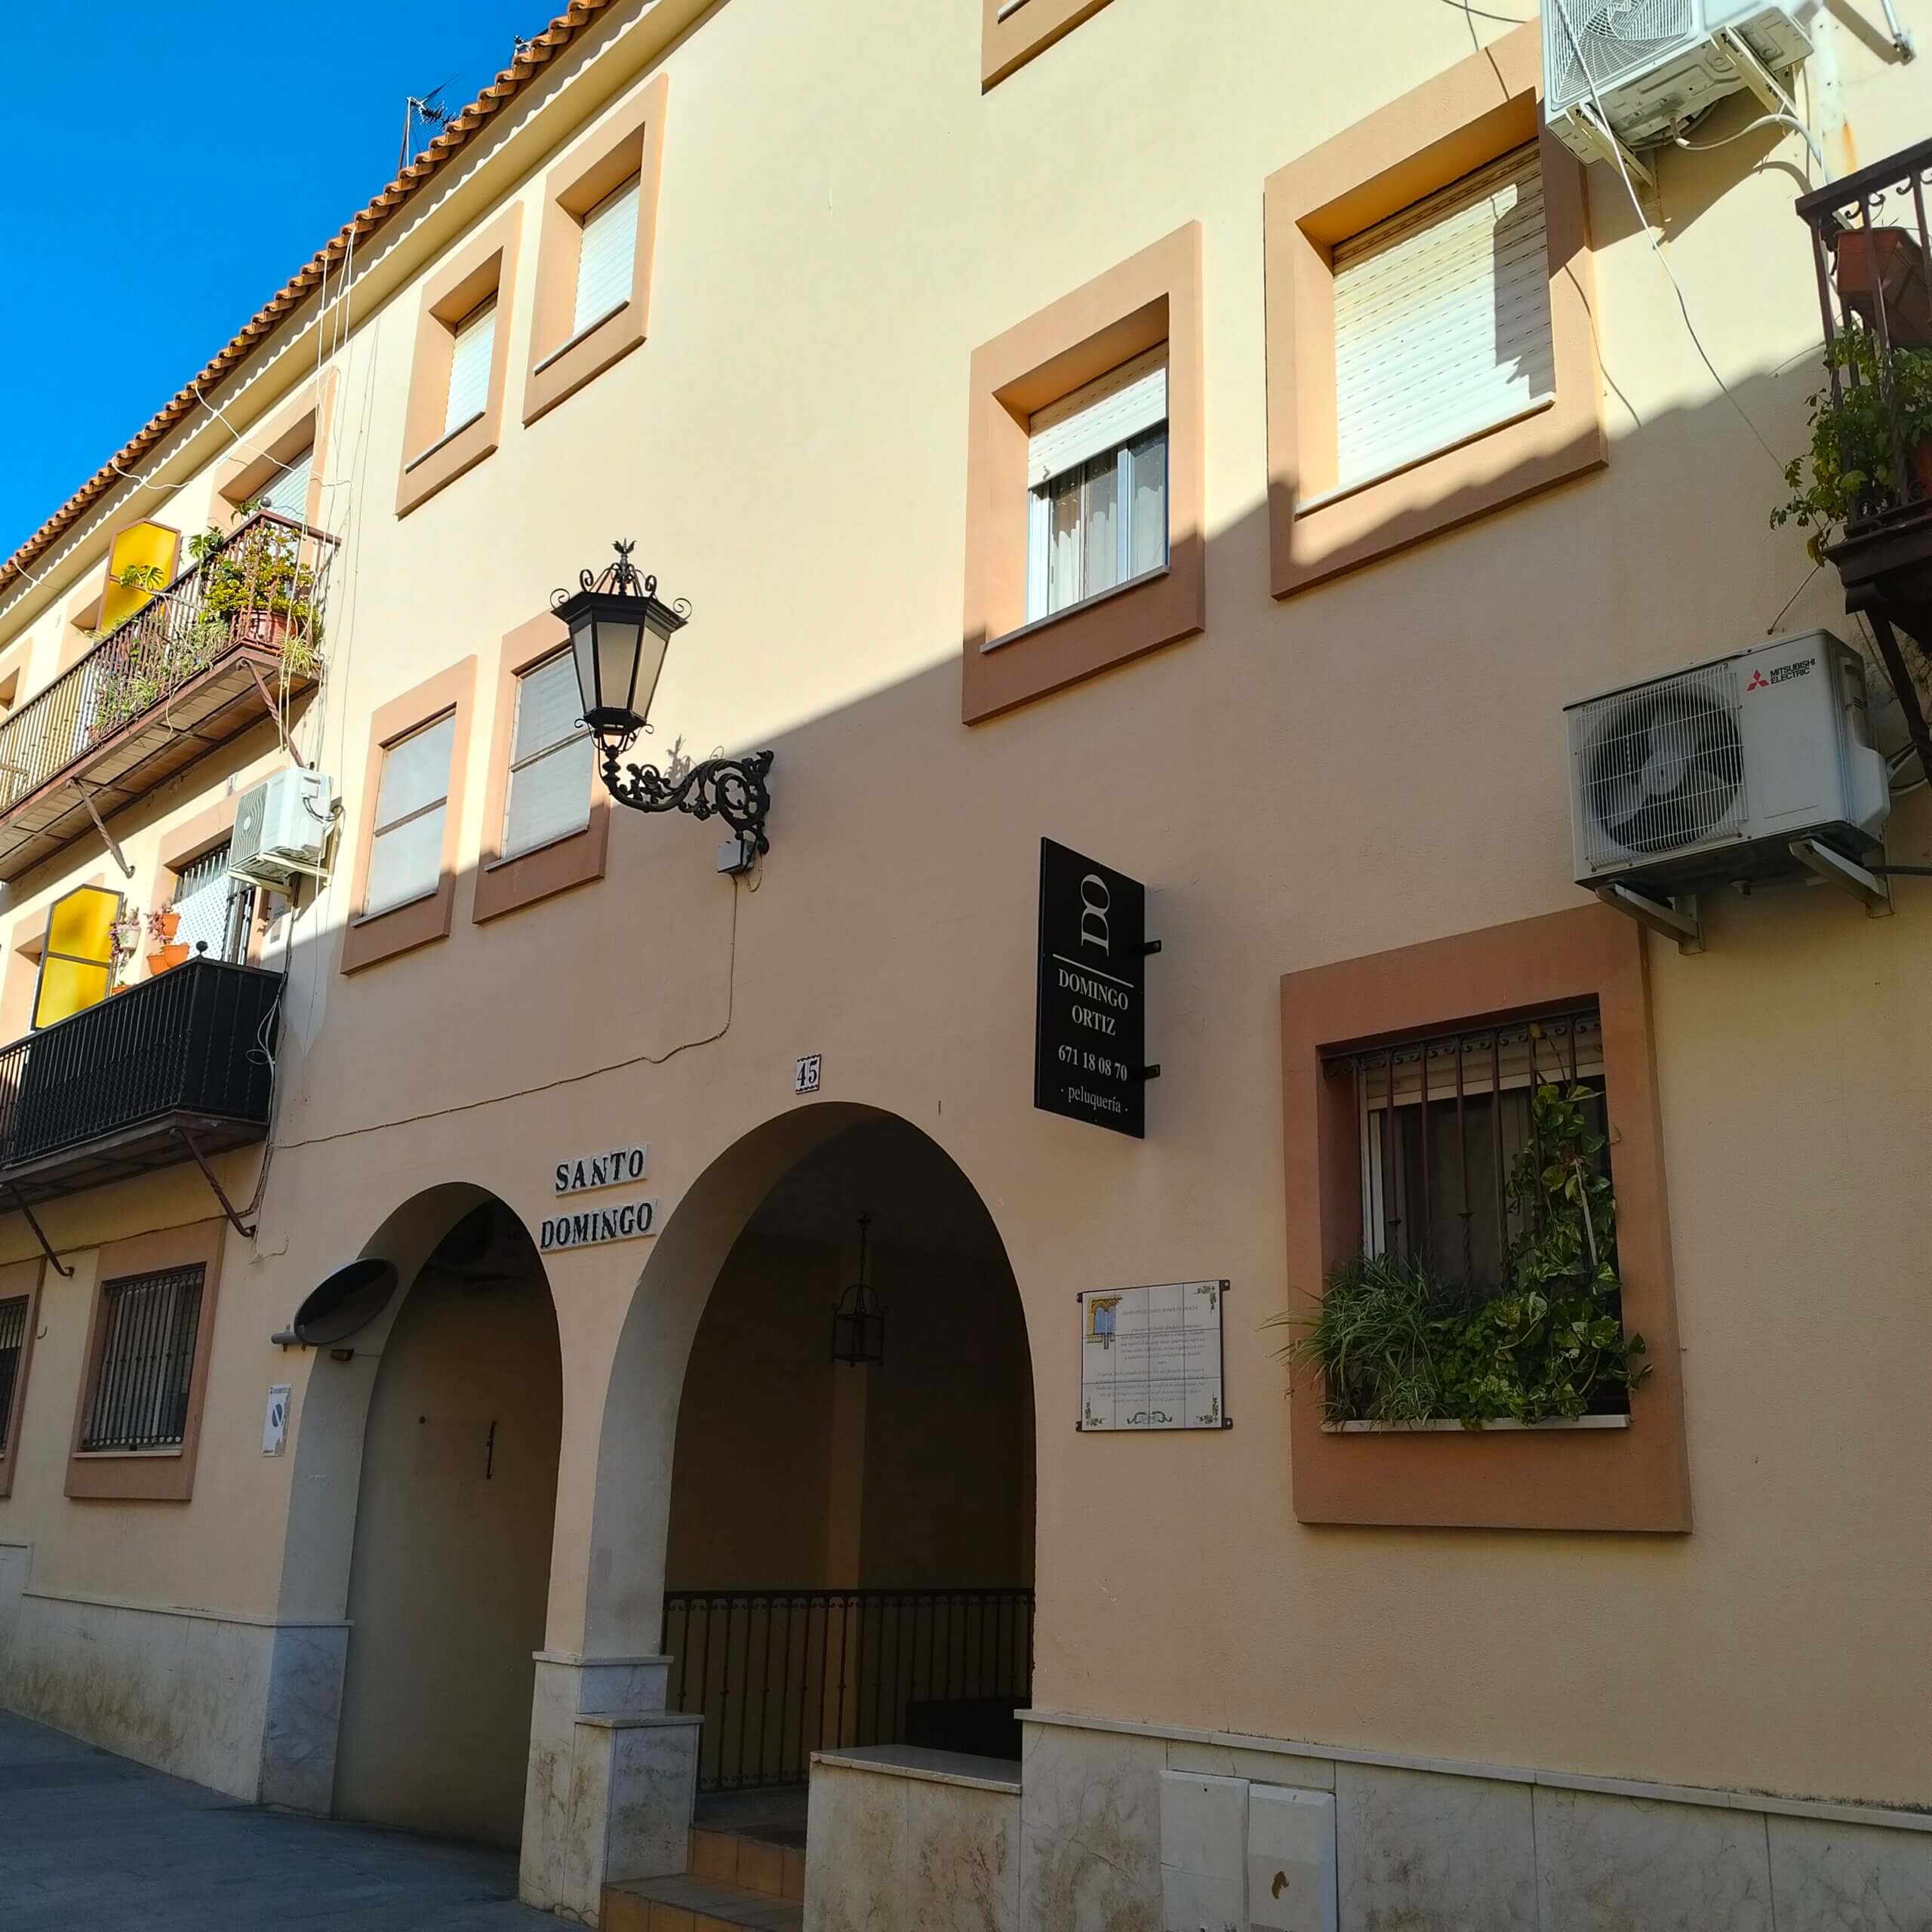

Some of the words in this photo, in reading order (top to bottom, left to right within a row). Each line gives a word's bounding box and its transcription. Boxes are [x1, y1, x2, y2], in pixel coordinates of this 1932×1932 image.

[1770, 657, 1816, 677] MITSUBISHI
[1770, 667, 1810, 685] ELECTRIC
[1081, 874, 1110, 957] DO
[1058, 968, 1129, 1011] DOMINGO
[1072, 1004, 1116, 1036] ORTIZ
[797, 1059, 818, 1087] 45
[1058, 1044, 1078, 1066] 671
[1082, 1051, 1096, 1072] 18
[1098, 1057, 1112, 1076] 08
[1114, 1063, 1128, 1081] 70
[1068, 1085, 1121, 1114] peluquería
[555, 1149, 645, 1192] SANTO
[540, 1201, 653, 1249] DOMINGO
